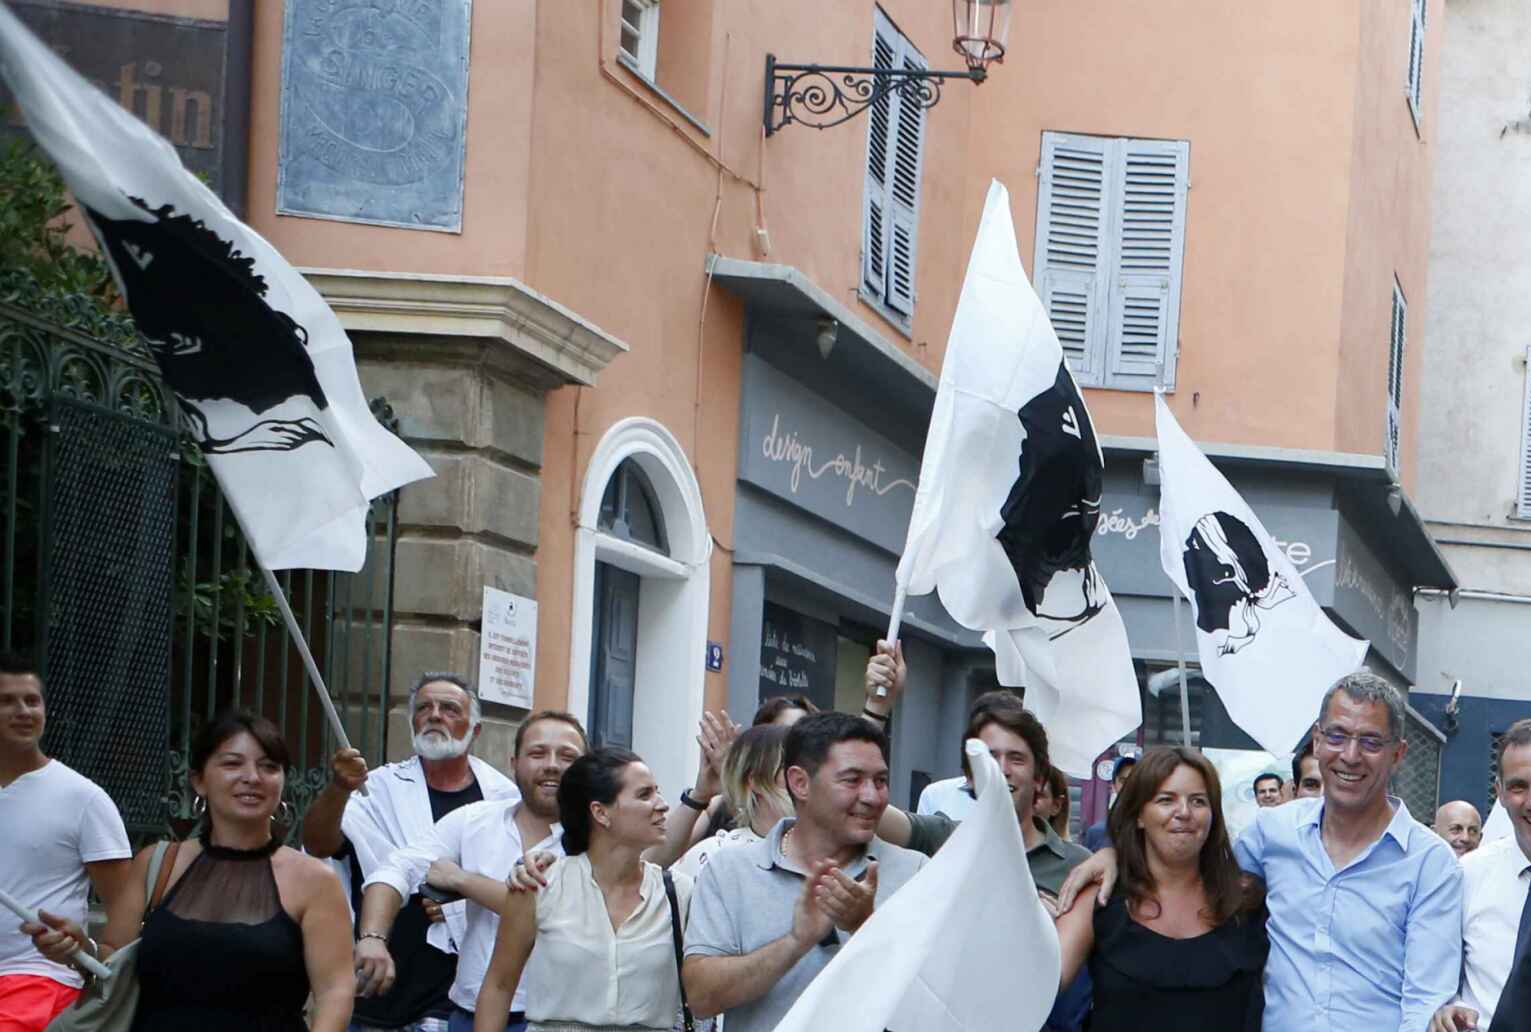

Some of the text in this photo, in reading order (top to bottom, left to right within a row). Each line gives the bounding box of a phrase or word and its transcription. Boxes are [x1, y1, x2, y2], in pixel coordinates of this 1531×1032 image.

[115, 61, 213, 149] tin
[763, 413, 818, 493] design
[1098, 508, 1137, 540] sées
